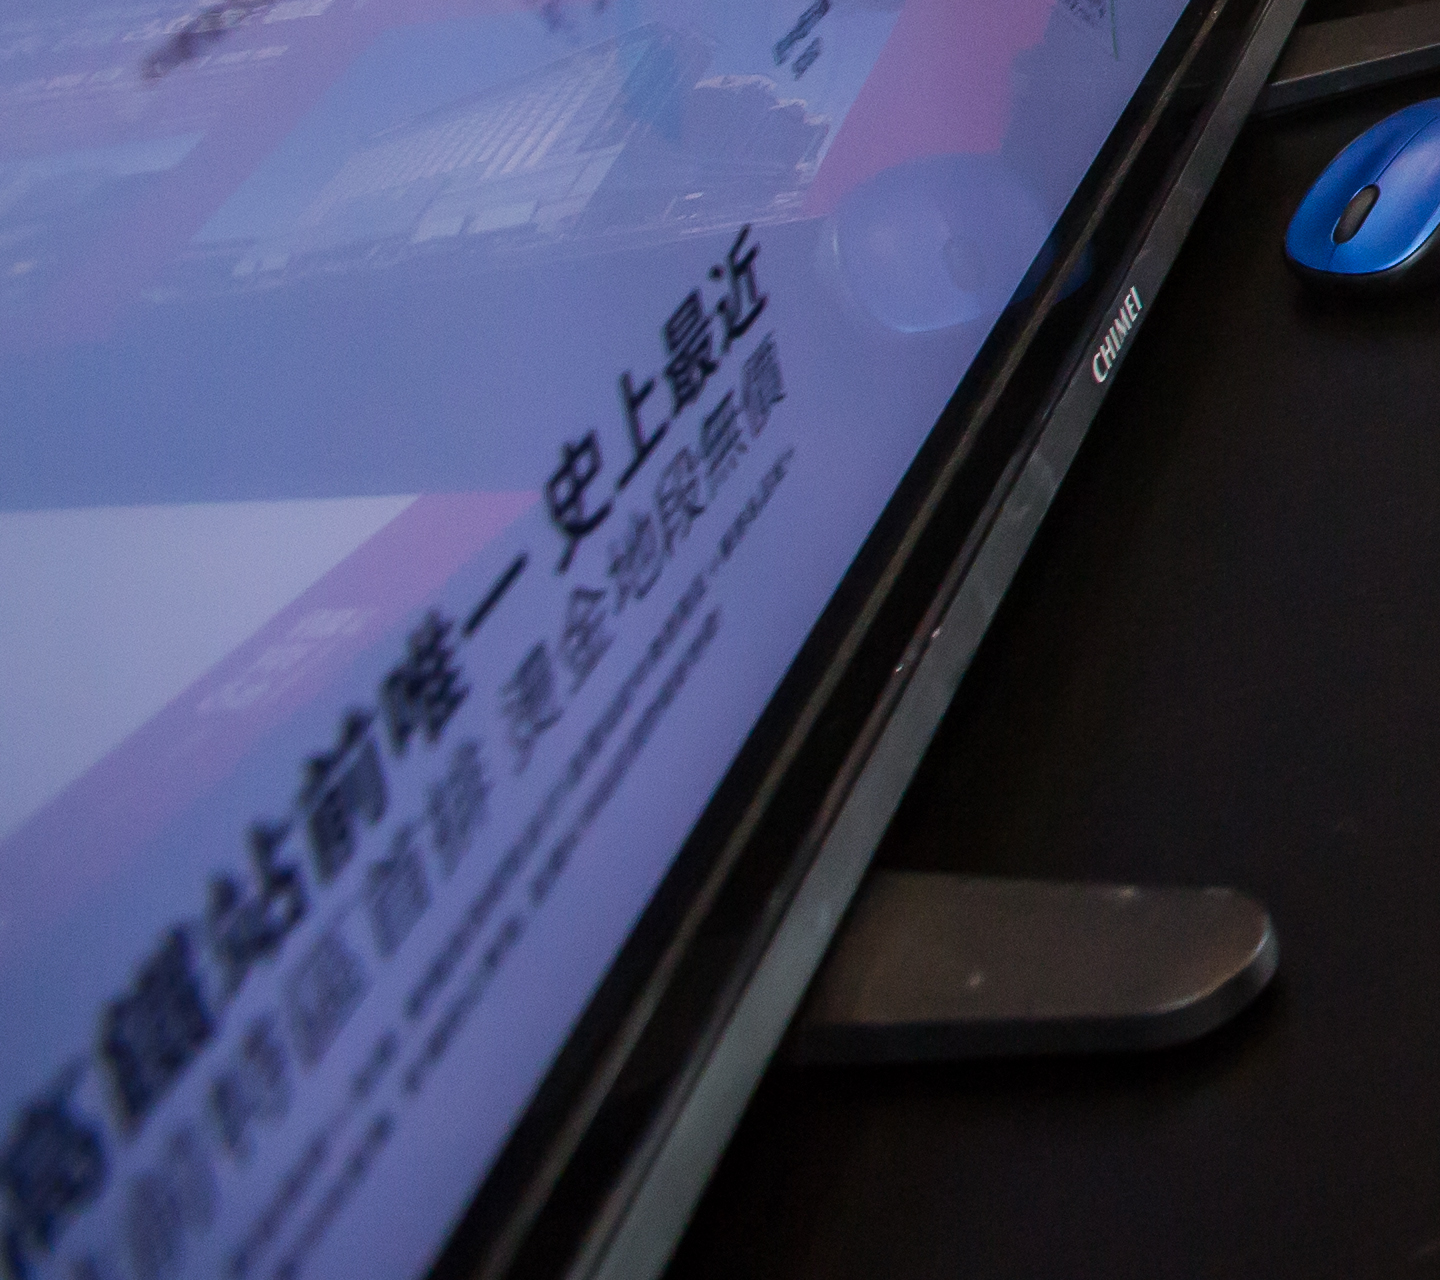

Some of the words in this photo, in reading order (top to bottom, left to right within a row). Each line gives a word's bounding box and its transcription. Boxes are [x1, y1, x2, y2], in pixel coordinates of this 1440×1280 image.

[546, 223, 769, 576] 史上最近
[1092, 285, 1144, 383] CHIMEI
